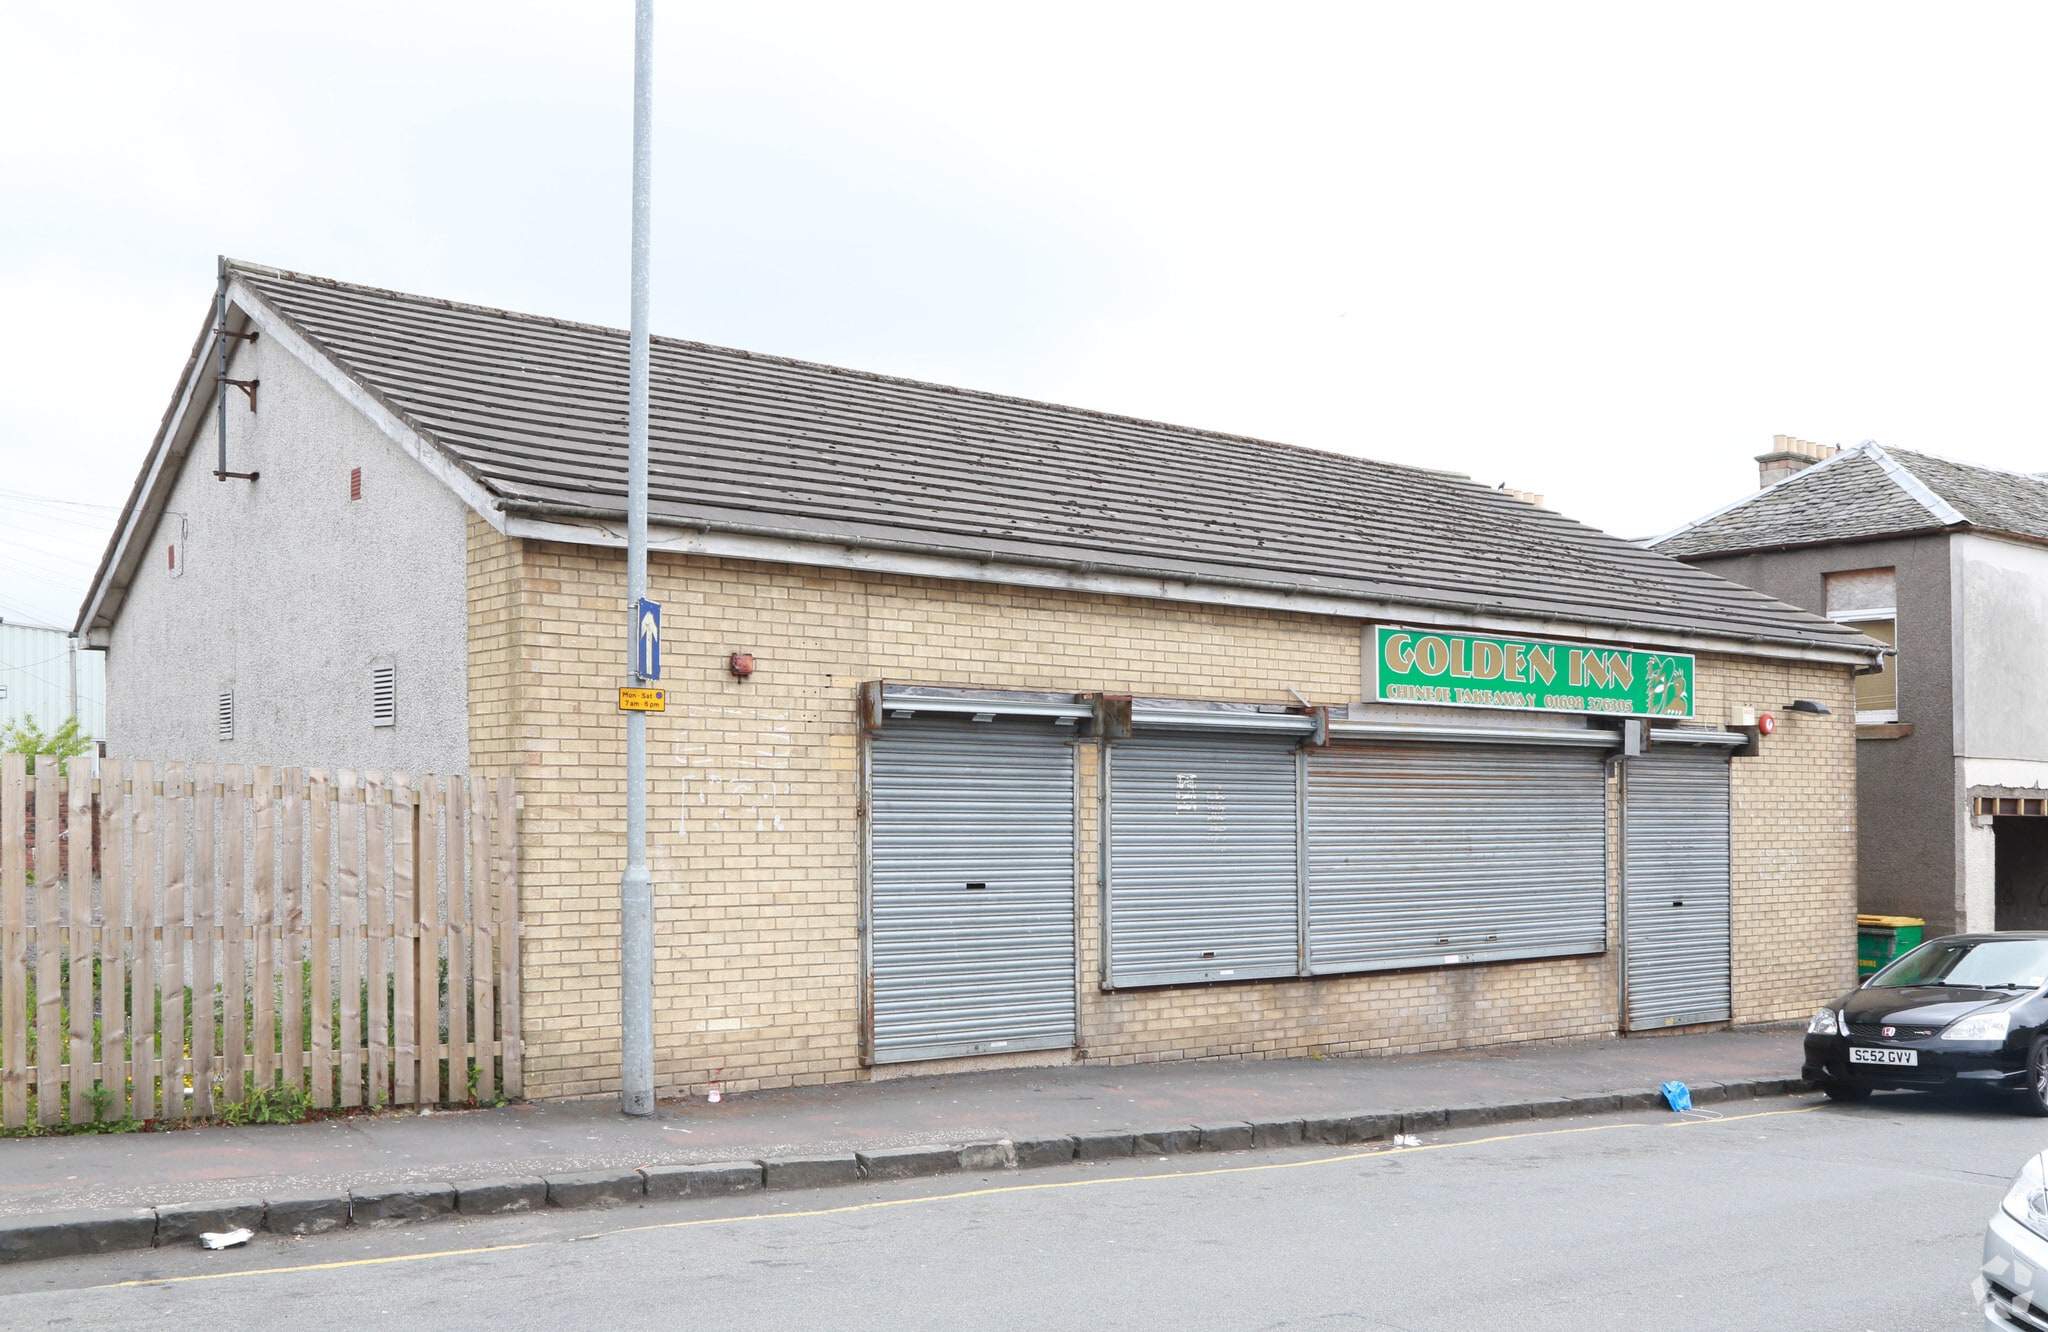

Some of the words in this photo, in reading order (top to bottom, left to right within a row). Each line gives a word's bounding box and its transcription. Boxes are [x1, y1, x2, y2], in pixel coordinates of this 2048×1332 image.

[1385, 634, 1557, 686] GOLDEN
[1569, 650, 1634, 691] INN
[1386, 683, 1451, 702] CHINESE
[1454, 687, 1536, 708] TAKEAWAY
[1544, 694, 1585, 710] 01698
[1587, 697, 1633, 713] 376305
[1855, 1049, 1885, 1062] SC52
[1888, 1051, 1911, 1063] GVV
